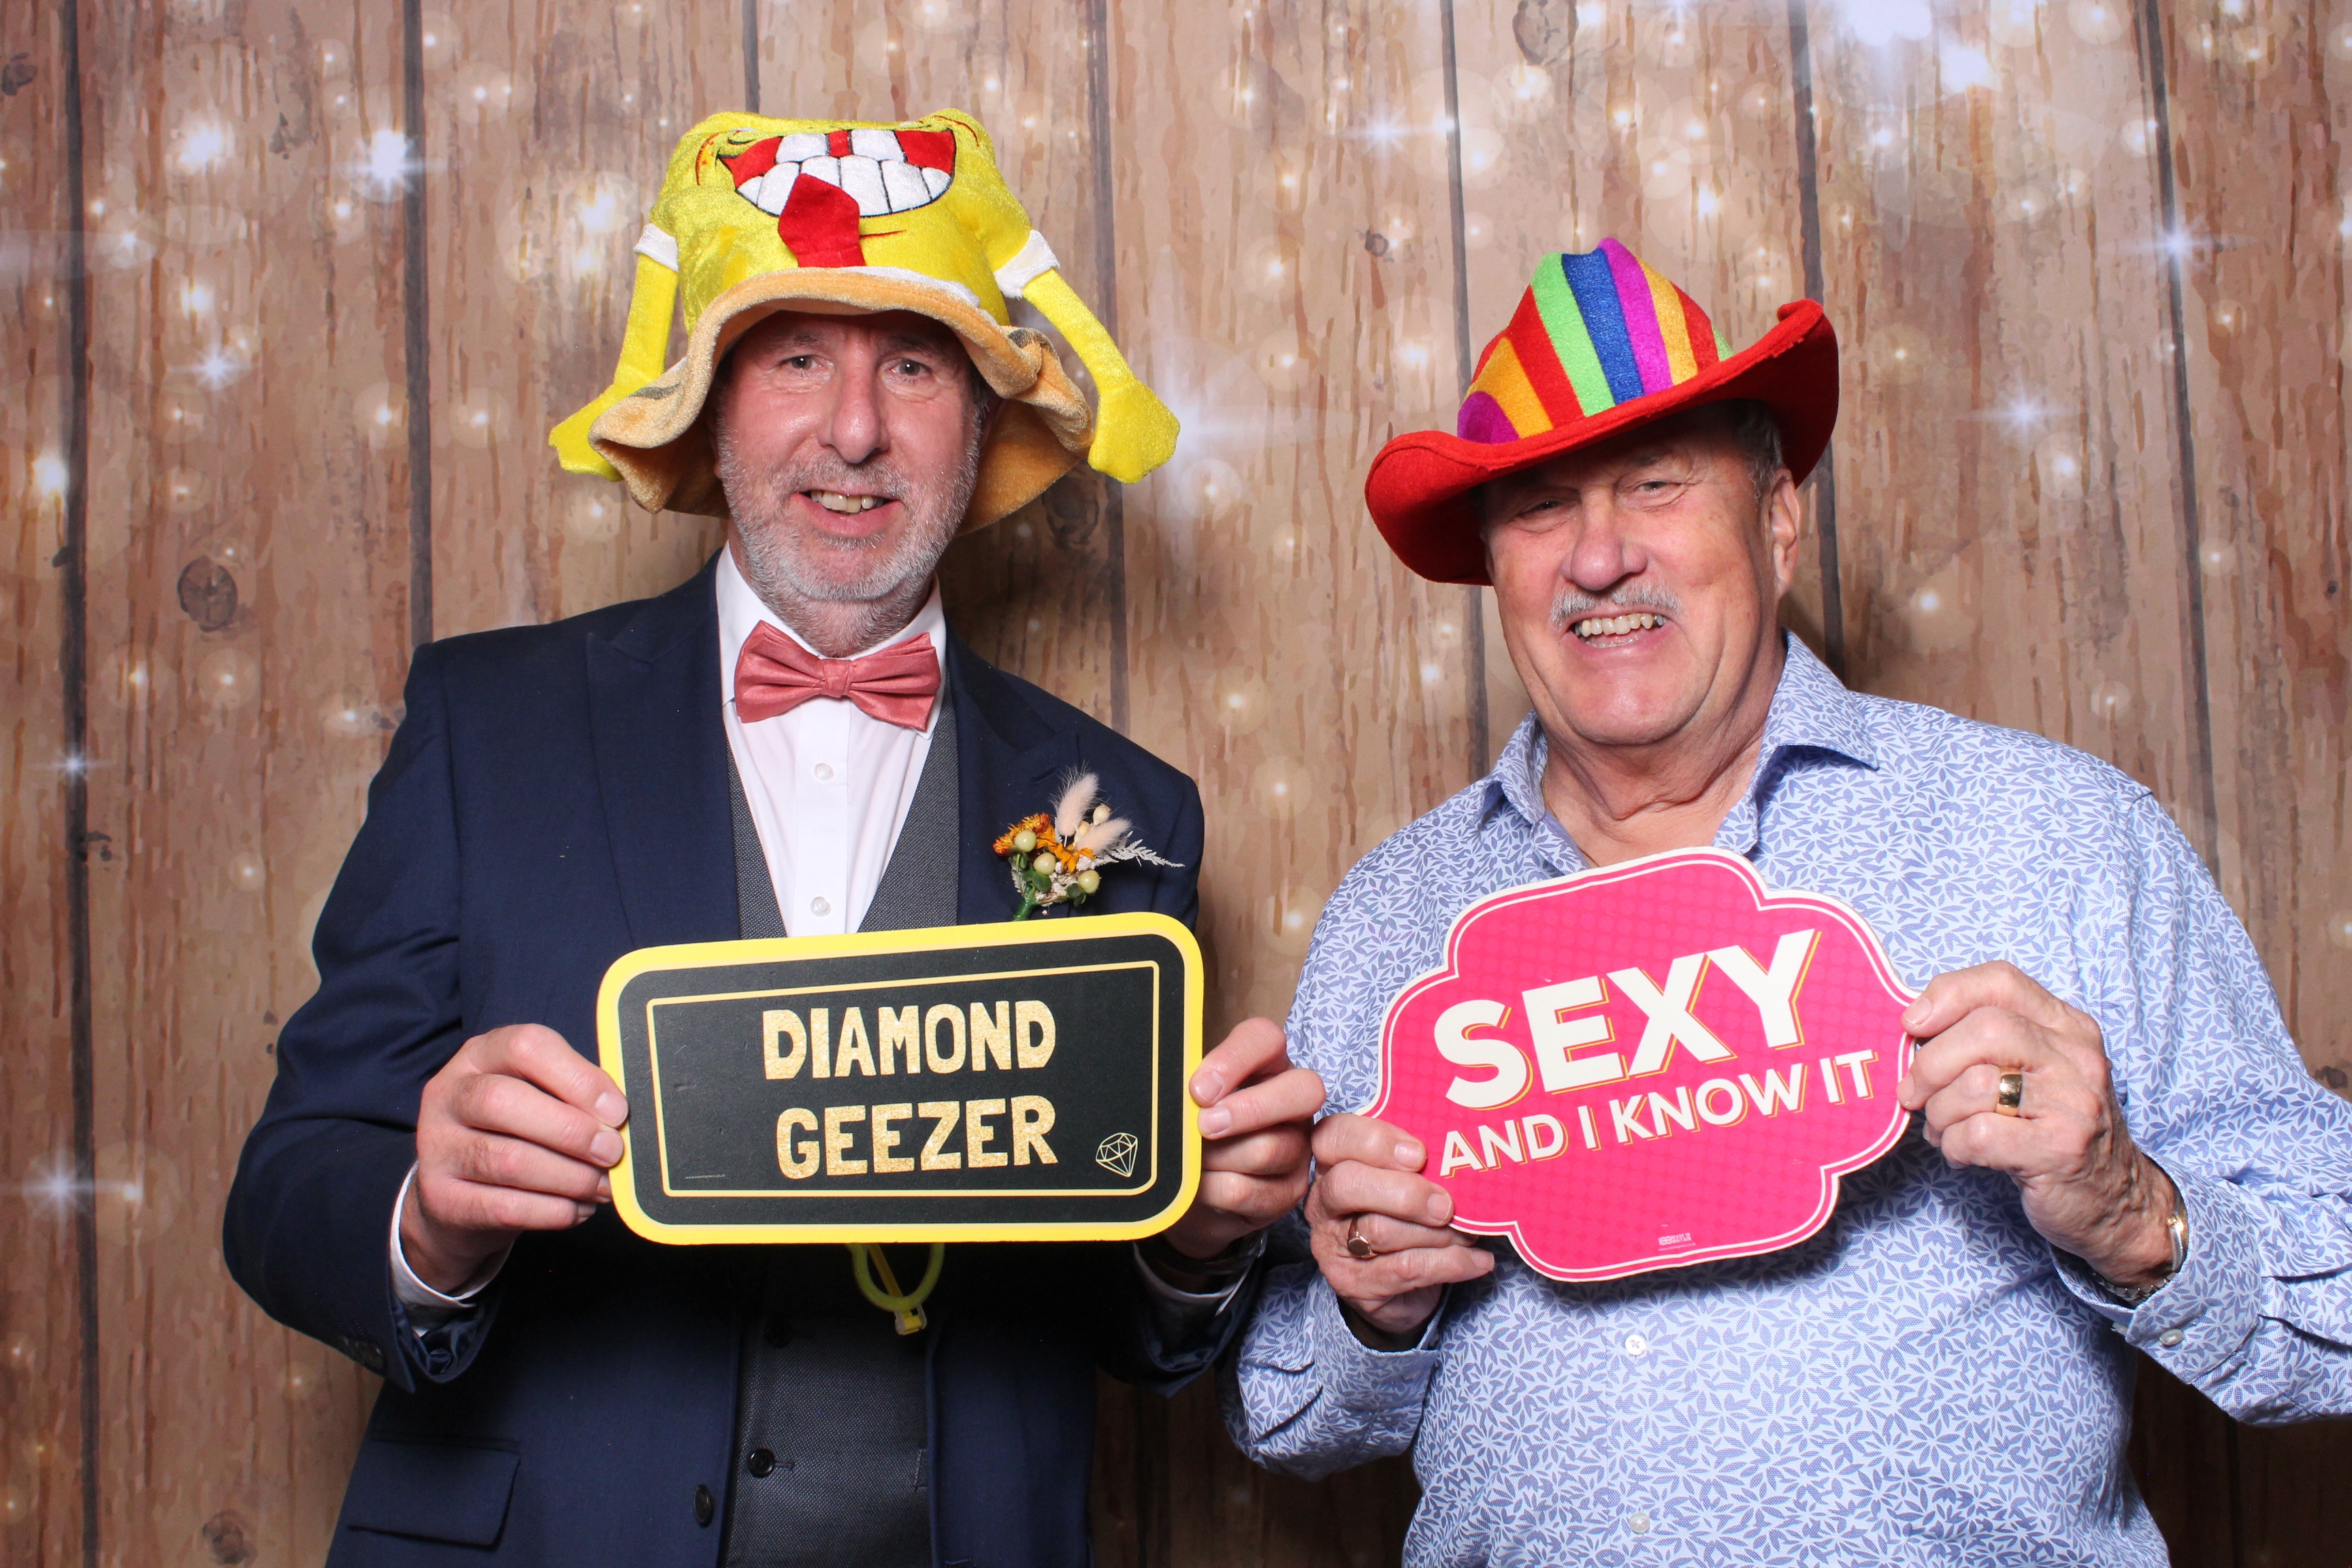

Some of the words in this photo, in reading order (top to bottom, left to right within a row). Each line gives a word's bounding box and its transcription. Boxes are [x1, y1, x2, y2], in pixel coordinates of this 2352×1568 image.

[762, 1000, 1056, 1080] DIAMOND
[1434, 928, 1821, 1111] SEXY
[777, 1094, 1058, 1179] GEEZER
[1439, 1113, 1568, 1177] AND
[1577, 1105, 1601, 1152] I
[1609, 1063, 1808, 1145] KNOW
[1820, 1049, 1878, 1105] IT
